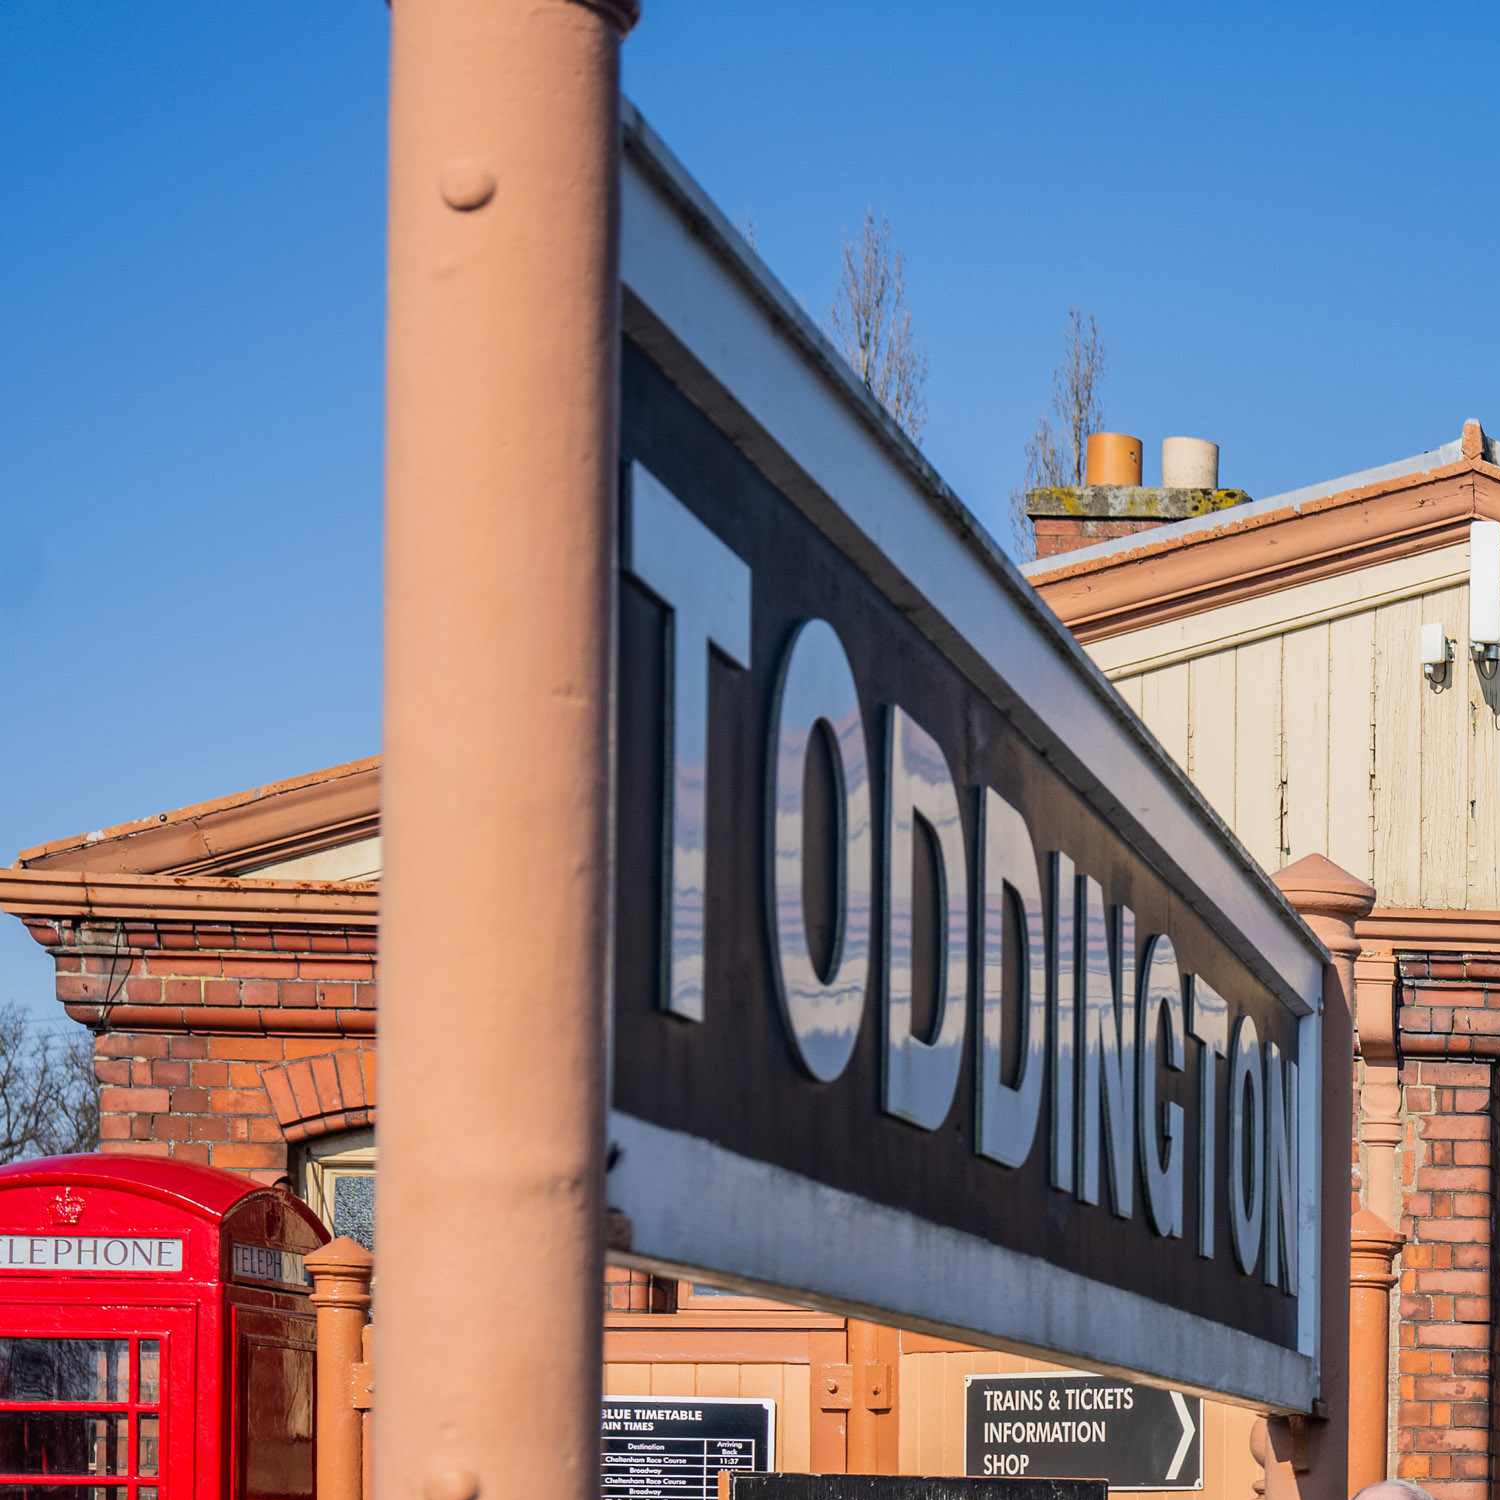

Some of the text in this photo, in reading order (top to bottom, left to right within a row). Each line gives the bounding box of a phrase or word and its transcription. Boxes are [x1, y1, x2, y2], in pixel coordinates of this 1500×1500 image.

[622, 458, 1299, 1298] TODDINGTON
[0, 1238, 175, 1267] LEPHONE
[984, 1387, 1134, 1411] TRAINS & TICKETS
[601, 1408, 703, 1421] BLUE TIMETABLE
[601, 1421, 655, 1432] AIN TIMES
[984, 1421, 1106, 1443] INFORMATION
[627, 1442, 665, 1451] Destination
[716, 1440, 743, 1450] Arriving
[720, 1457, 739, 1465] 11:37
[983, 1454, 1030, 1475] SHOP
[629, 1467, 662, 1476] Broadway
[628, 1488, 662, 1496] Broadway
